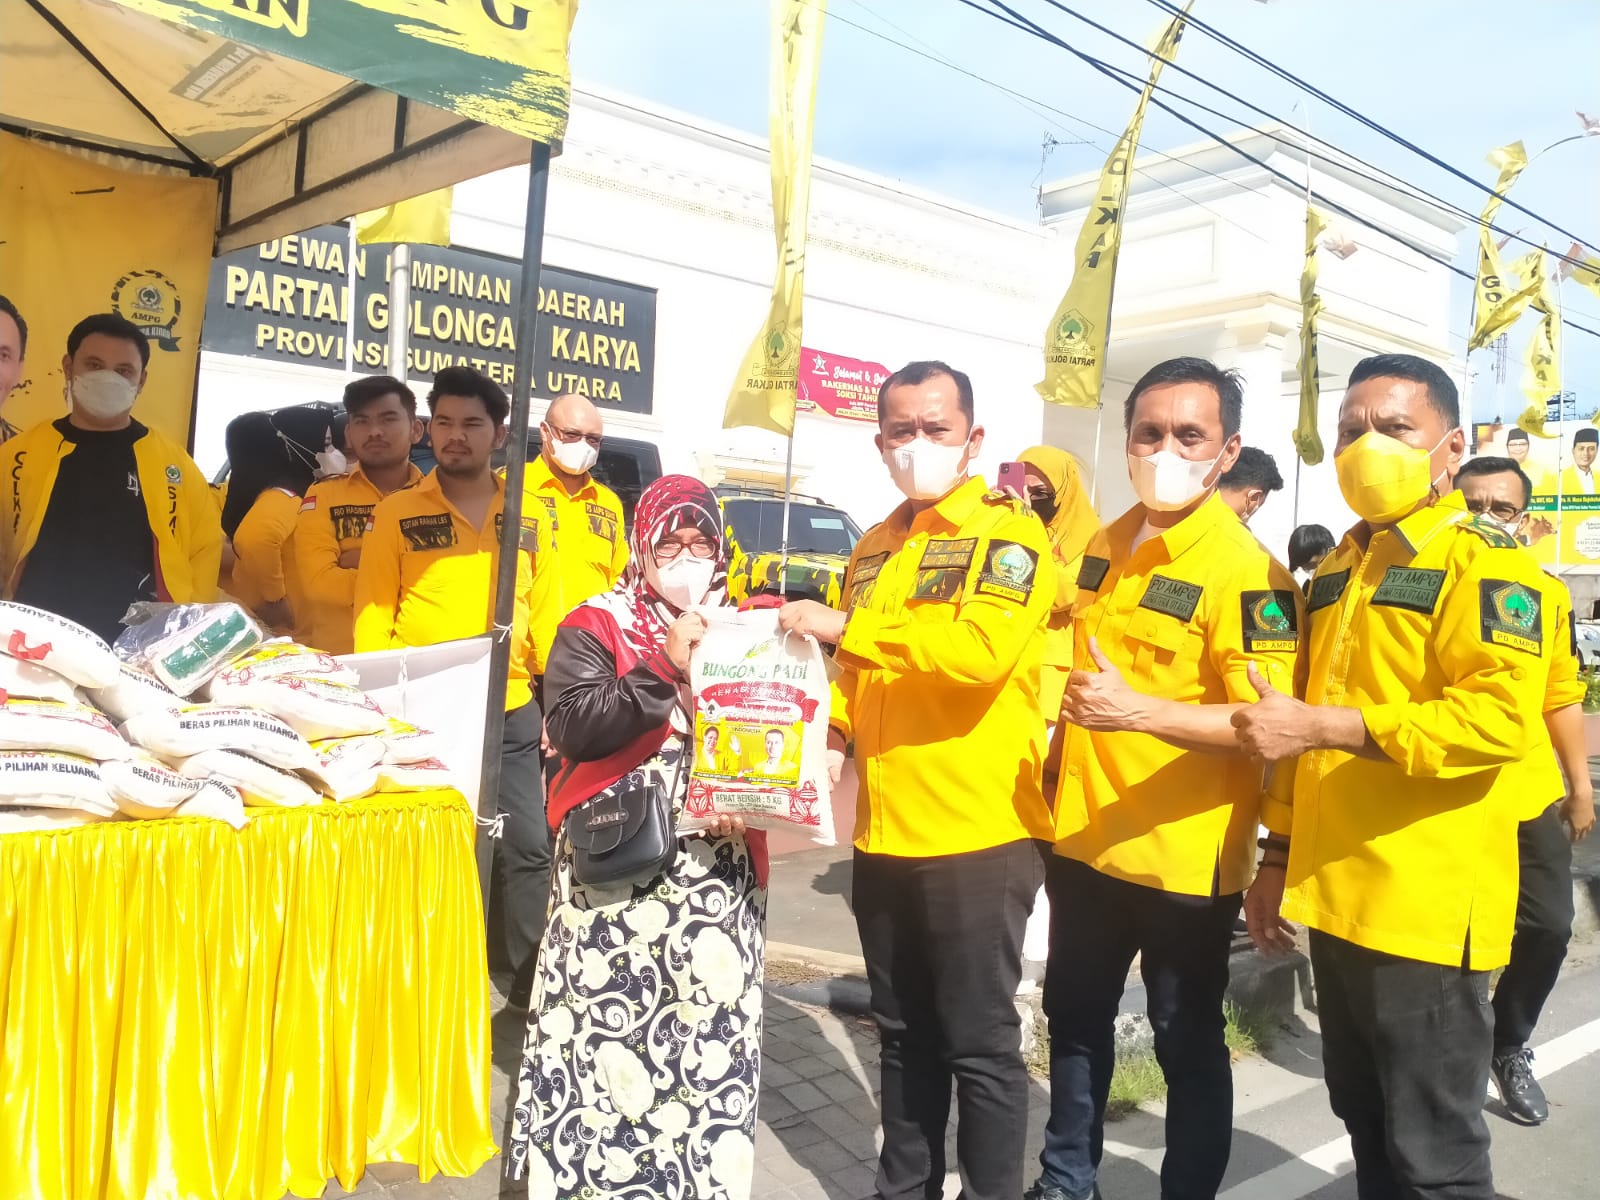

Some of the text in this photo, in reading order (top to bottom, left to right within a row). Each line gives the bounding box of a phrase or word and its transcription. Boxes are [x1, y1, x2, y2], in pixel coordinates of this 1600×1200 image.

[131, 312, 161, 323] AMPG
[226, 265, 349, 322] PARTAI
[551, 325, 641, 373] KARYA
[547, 371, 622, 401] UTARA
[821, 380, 863, 393] RAKERNAS
[1402, 571, 1439, 587] AMPG
[1164, 582, 1197, 601] AMPG
[1256, 642, 1293, 650] PD AMPG
[1513, 637, 1538, 651] AMPG
[772, 663, 808, 680] PADI
[179, 718, 299, 742] BERAS PILIHAN KELUARGA
[5, 762, 48, 772] PILIHAN
[132, 766, 161, 784] BERAS
[162, 778, 200, 791] PILIHAN
